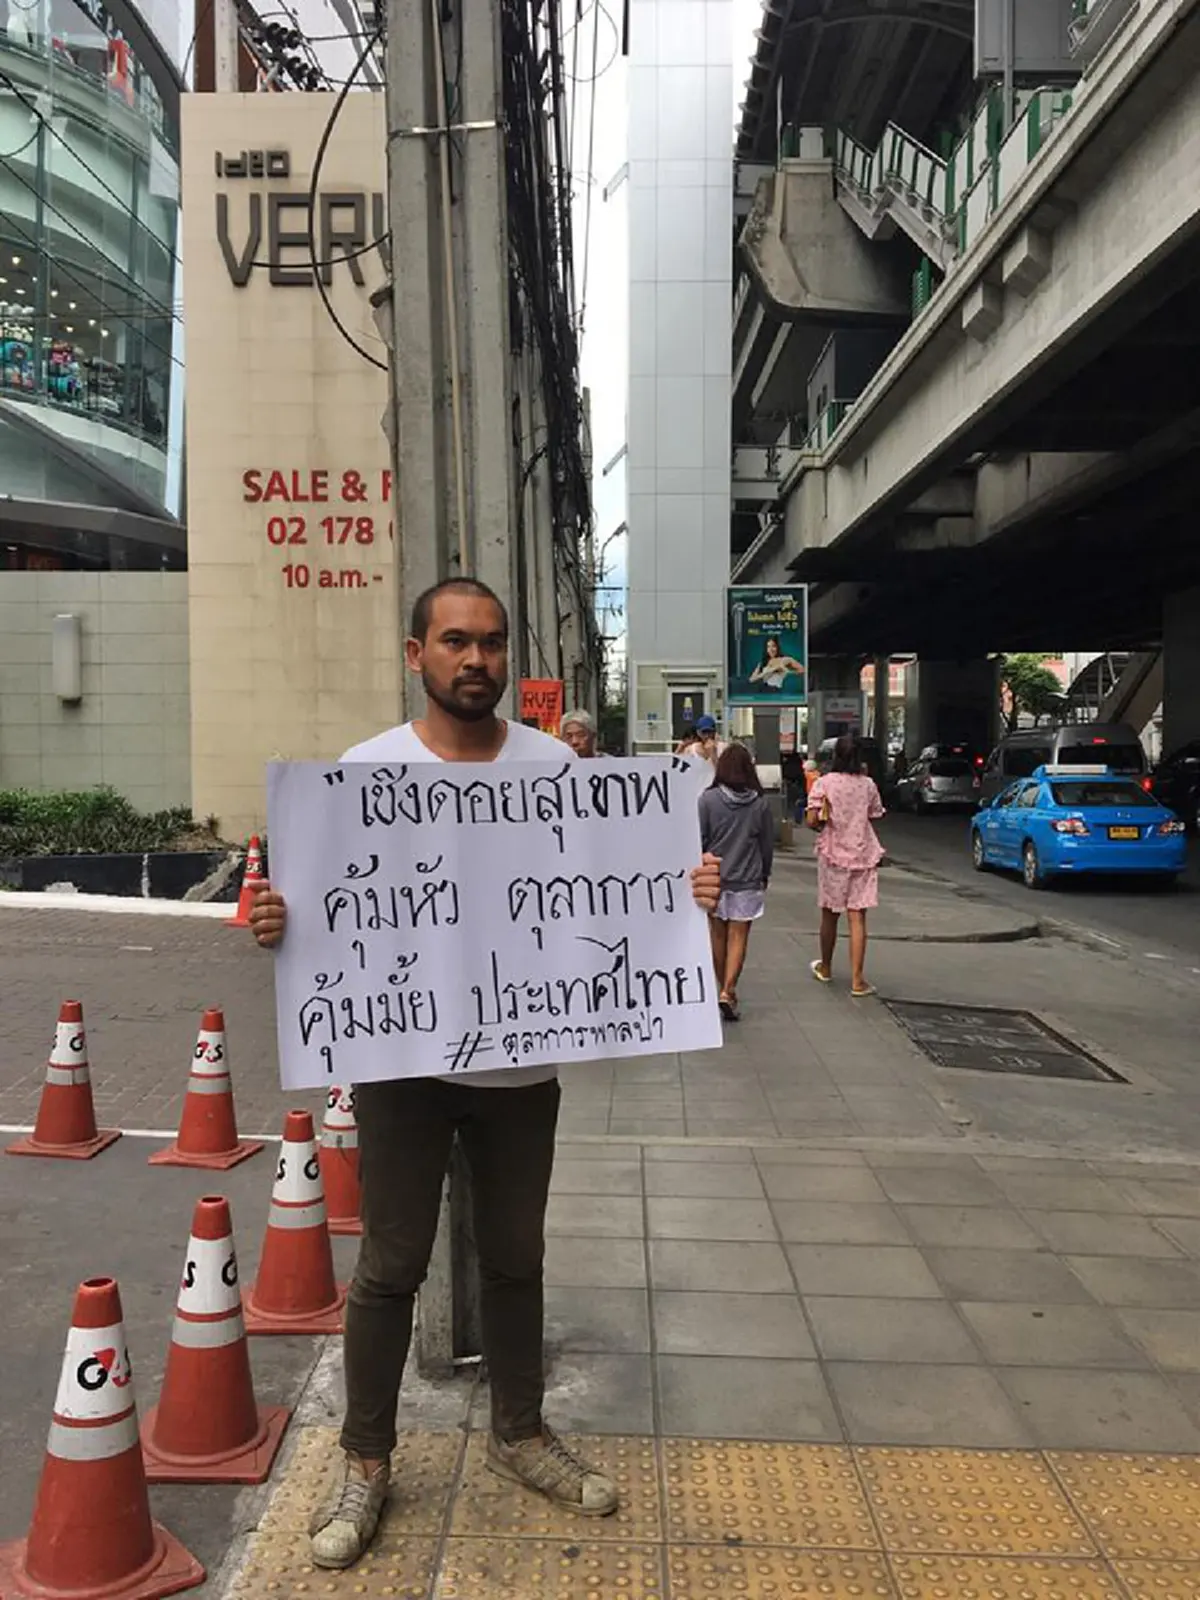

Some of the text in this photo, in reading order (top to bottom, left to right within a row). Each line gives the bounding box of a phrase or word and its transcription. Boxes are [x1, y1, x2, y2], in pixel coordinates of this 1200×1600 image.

[242, 469, 329, 502] SALE
[341, 470, 368, 502] &
[267, 516, 307, 545] 02
[320, 516, 374, 545] 178
[282, 564, 310, 588] 10
[508, 869, 685, 950] ตุลาการ
[471, 937, 705, 1025] ประเทศไทย
